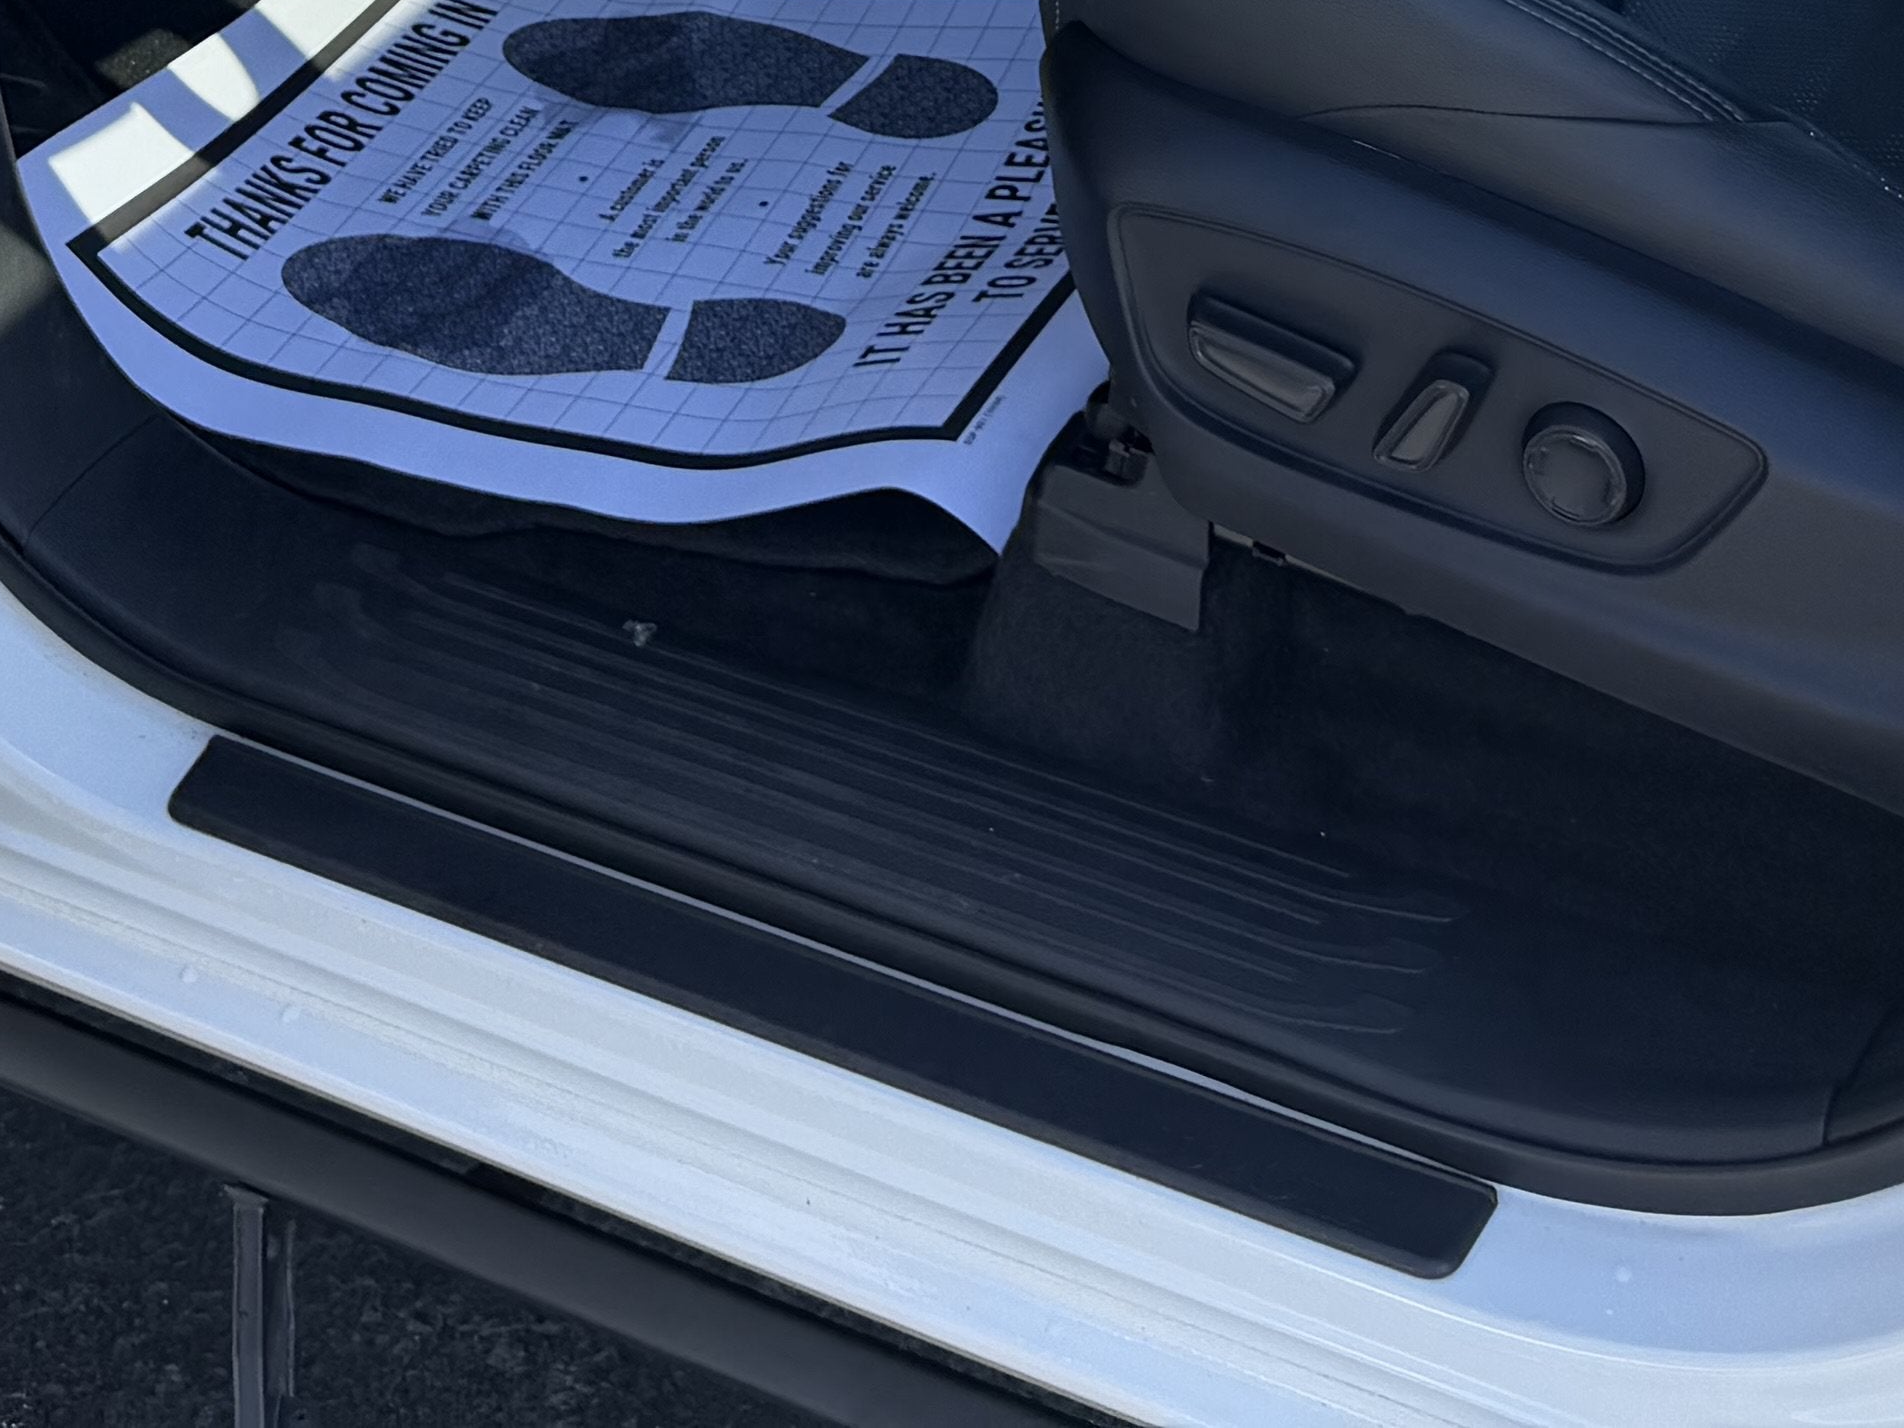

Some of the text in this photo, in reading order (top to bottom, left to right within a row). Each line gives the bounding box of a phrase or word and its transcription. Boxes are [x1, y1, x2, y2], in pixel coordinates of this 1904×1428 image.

[184, 154, 332, 261] THANKS
[288, 109, 383, 167] FOR
[341, 23, 471, 116] COMING
[392, 162, 433, 191] HAVE
[446, 121, 473, 135] TO
[461, 97, 493, 122] KEEP
[420, 190, 461, 217] YOUR
[499, 106, 543, 138] CLEAN
[469, 194, 509, 222] WITH
[763, 161, 854, 267] Your suggestions for
[804, 223, 864, 276] improving
[860, 165, 897, 202] service
[972, 210, 1024, 228] A
[866, 223, 905, 260] always
[920, 235, 1008, 287] BEEN
[972, 275, 1036, 303] TO
[876, 292, 956, 336] HAS
[853, 345, 910, 367] IT
